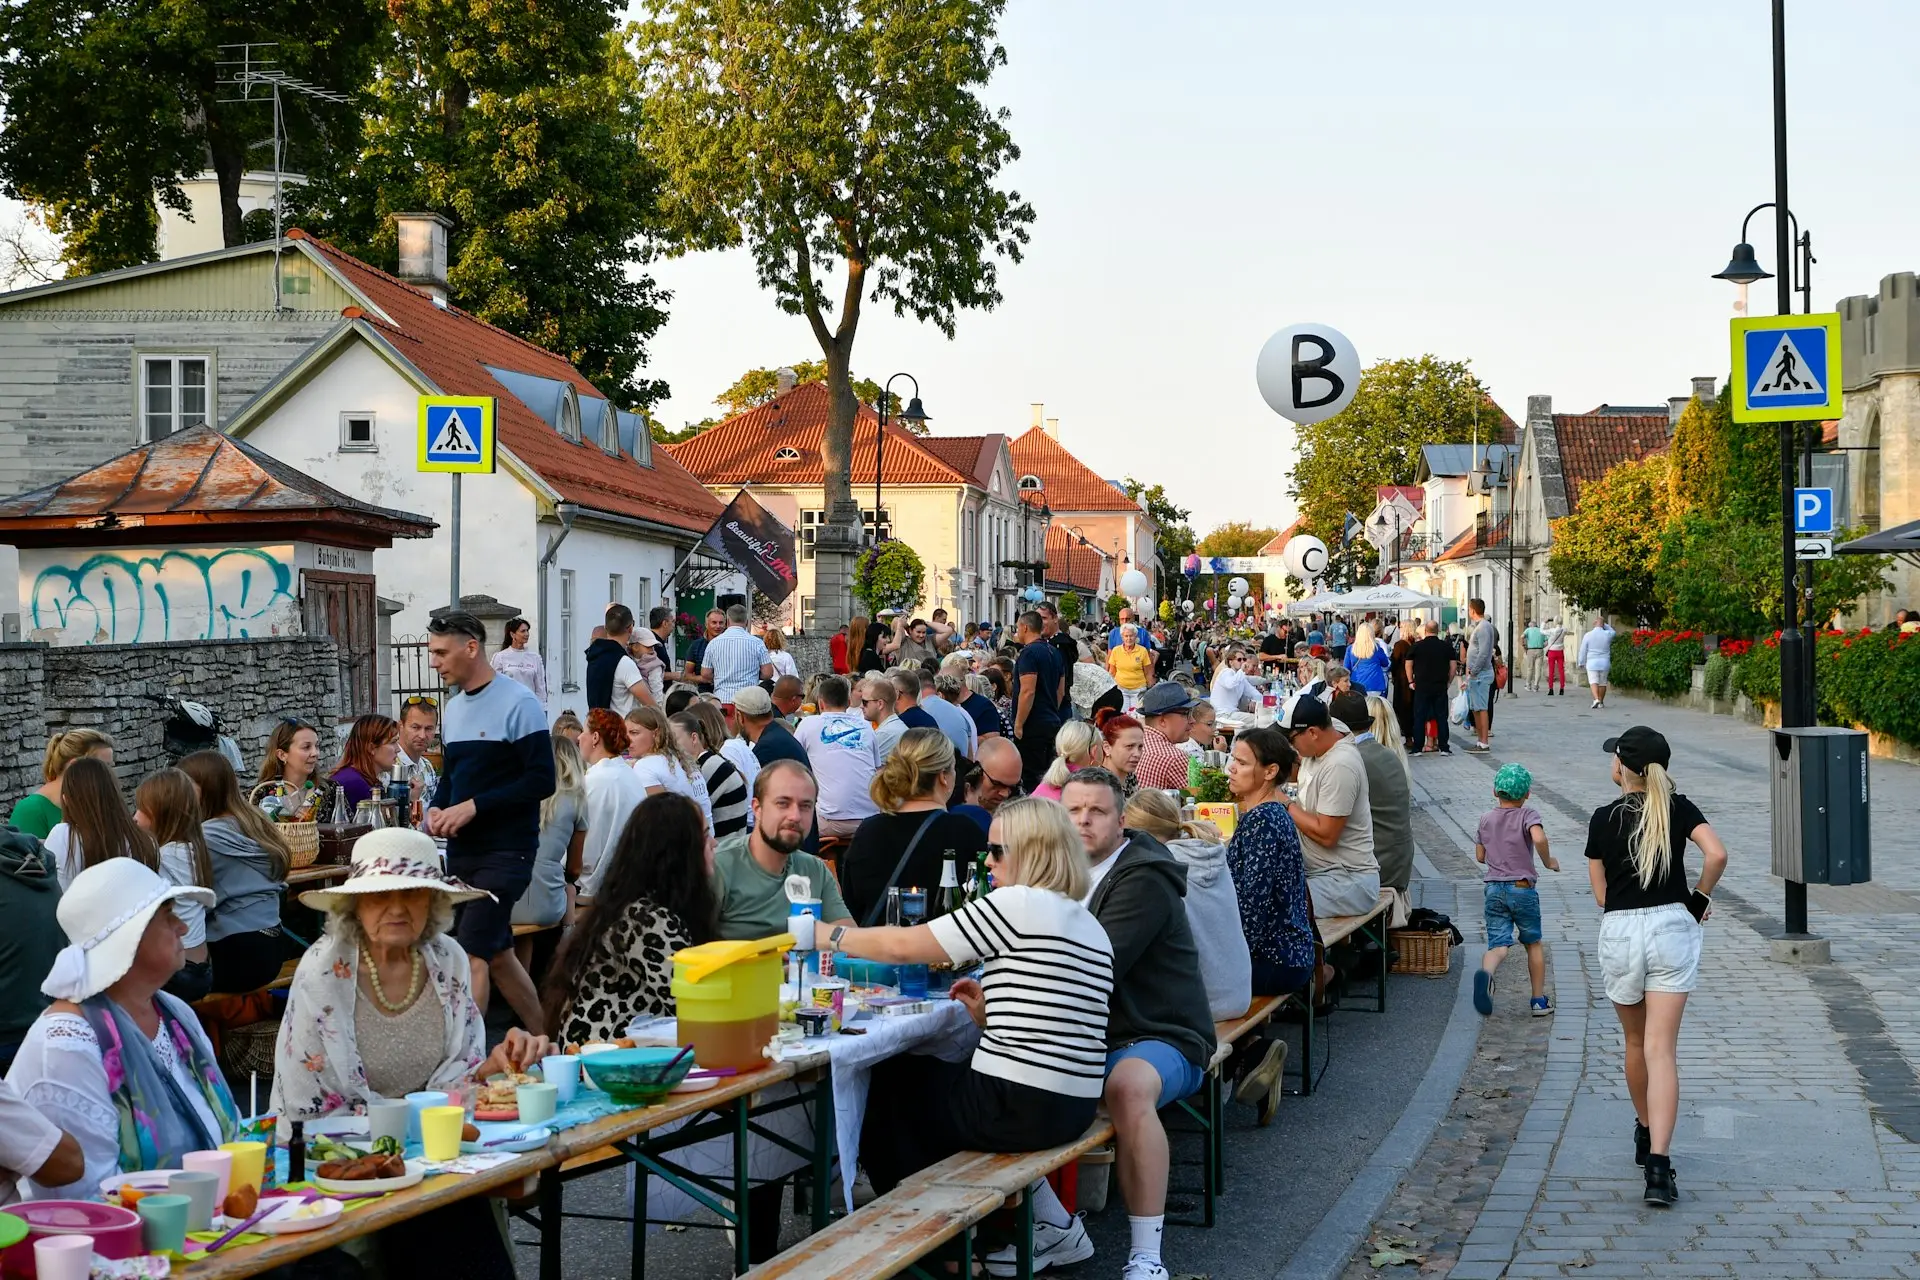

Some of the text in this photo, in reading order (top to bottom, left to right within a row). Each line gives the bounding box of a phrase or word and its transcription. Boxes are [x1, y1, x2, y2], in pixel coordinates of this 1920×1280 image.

[1291, 333, 1345, 409] B
[1798, 493, 1822, 528] P
[726, 521, 768, 555] Beautiful
[1302, 547, 1323, 573] C
[1229, 580, 1237, 592] E
[1211, 807, 1231, 815] LOTTE
